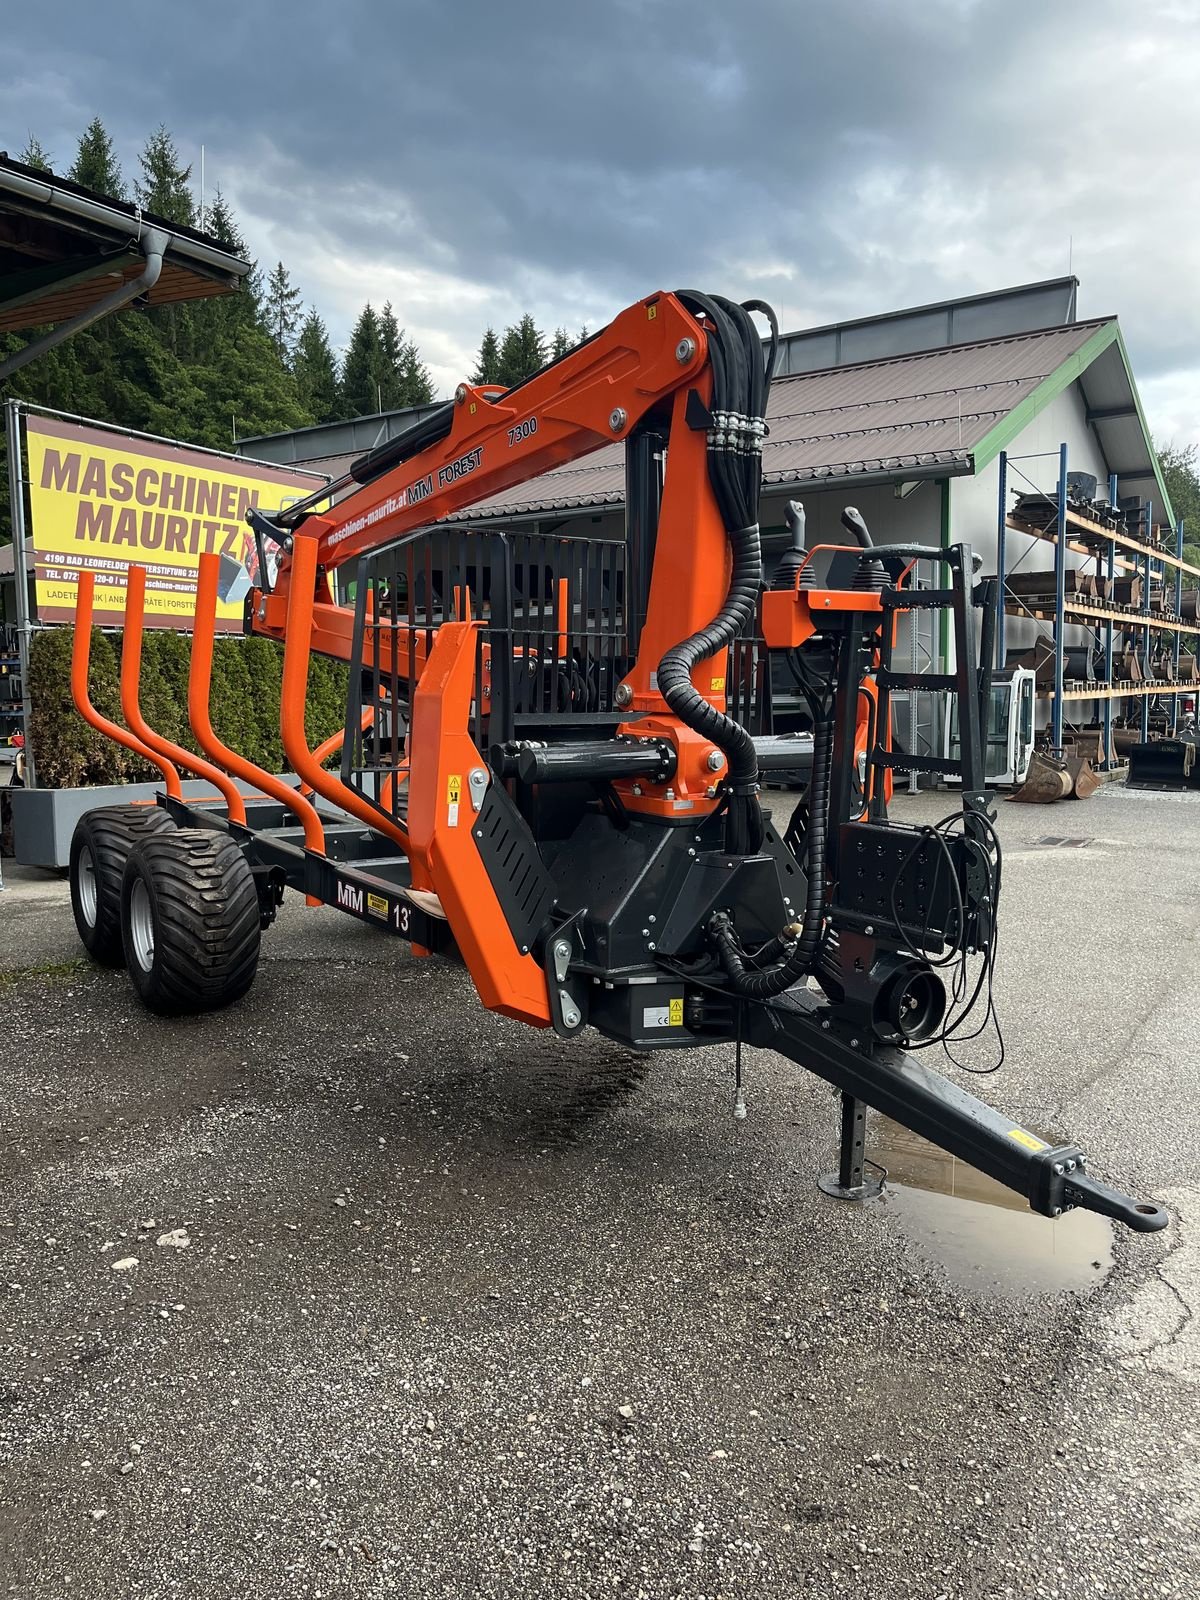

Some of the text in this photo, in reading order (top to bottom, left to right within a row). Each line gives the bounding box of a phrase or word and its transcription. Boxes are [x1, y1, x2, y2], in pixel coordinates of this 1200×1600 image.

[41, 448, 259, 521] MASCHINEN
[407, 416, 537, 506] MTM FOREST 7300
[75, 501, 240, 560] MAURITZ
[328, 490, 407, 545] maschinen-mauritz.at
[44, 554, 65, 564] 4190
[66, 556, 82, 566] BAD
[84, 558, 129, 571] LEONFELDEN
[46, 570, 61, 579] TEL.
[338, 881, 363, 912] MTM
